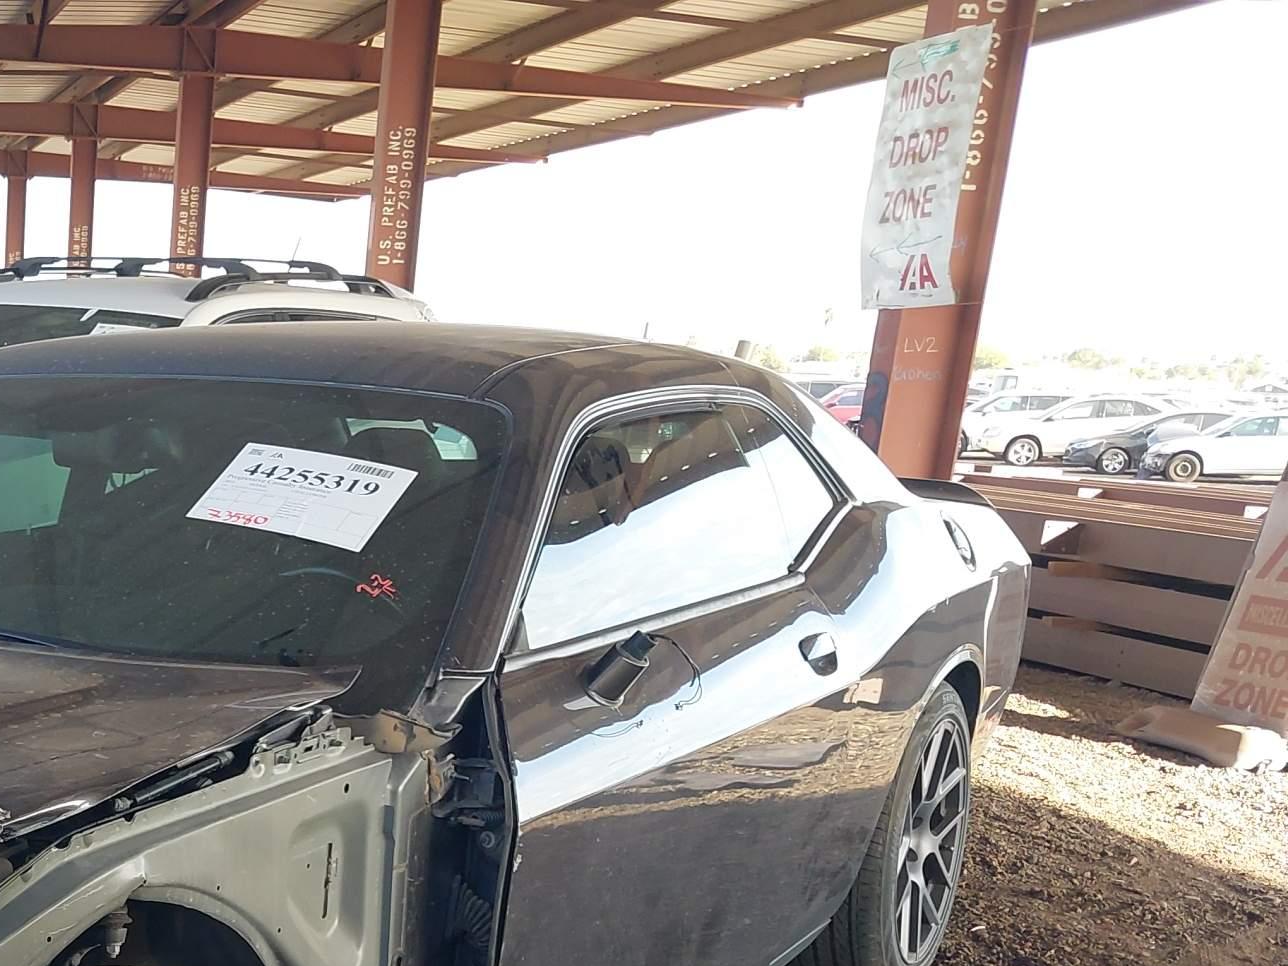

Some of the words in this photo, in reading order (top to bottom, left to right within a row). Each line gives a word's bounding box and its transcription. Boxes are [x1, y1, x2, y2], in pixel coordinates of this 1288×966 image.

[899, 70, 956, 113] MISC.
[387, 125, 403, 156] INC.
[888, 126, 950, 169] DROP
[380, 164, 399, 226] PREFAB
[878, 184, 937, 225] ZONE
[377, 235, 392, 265] U.S.
[903, 336, 939, 353] LV2
[243, 462, 380, 496] 44255319
[1228, 642, 1288, 679] DRO
[1213, 679, 1288, 720] ZONE
